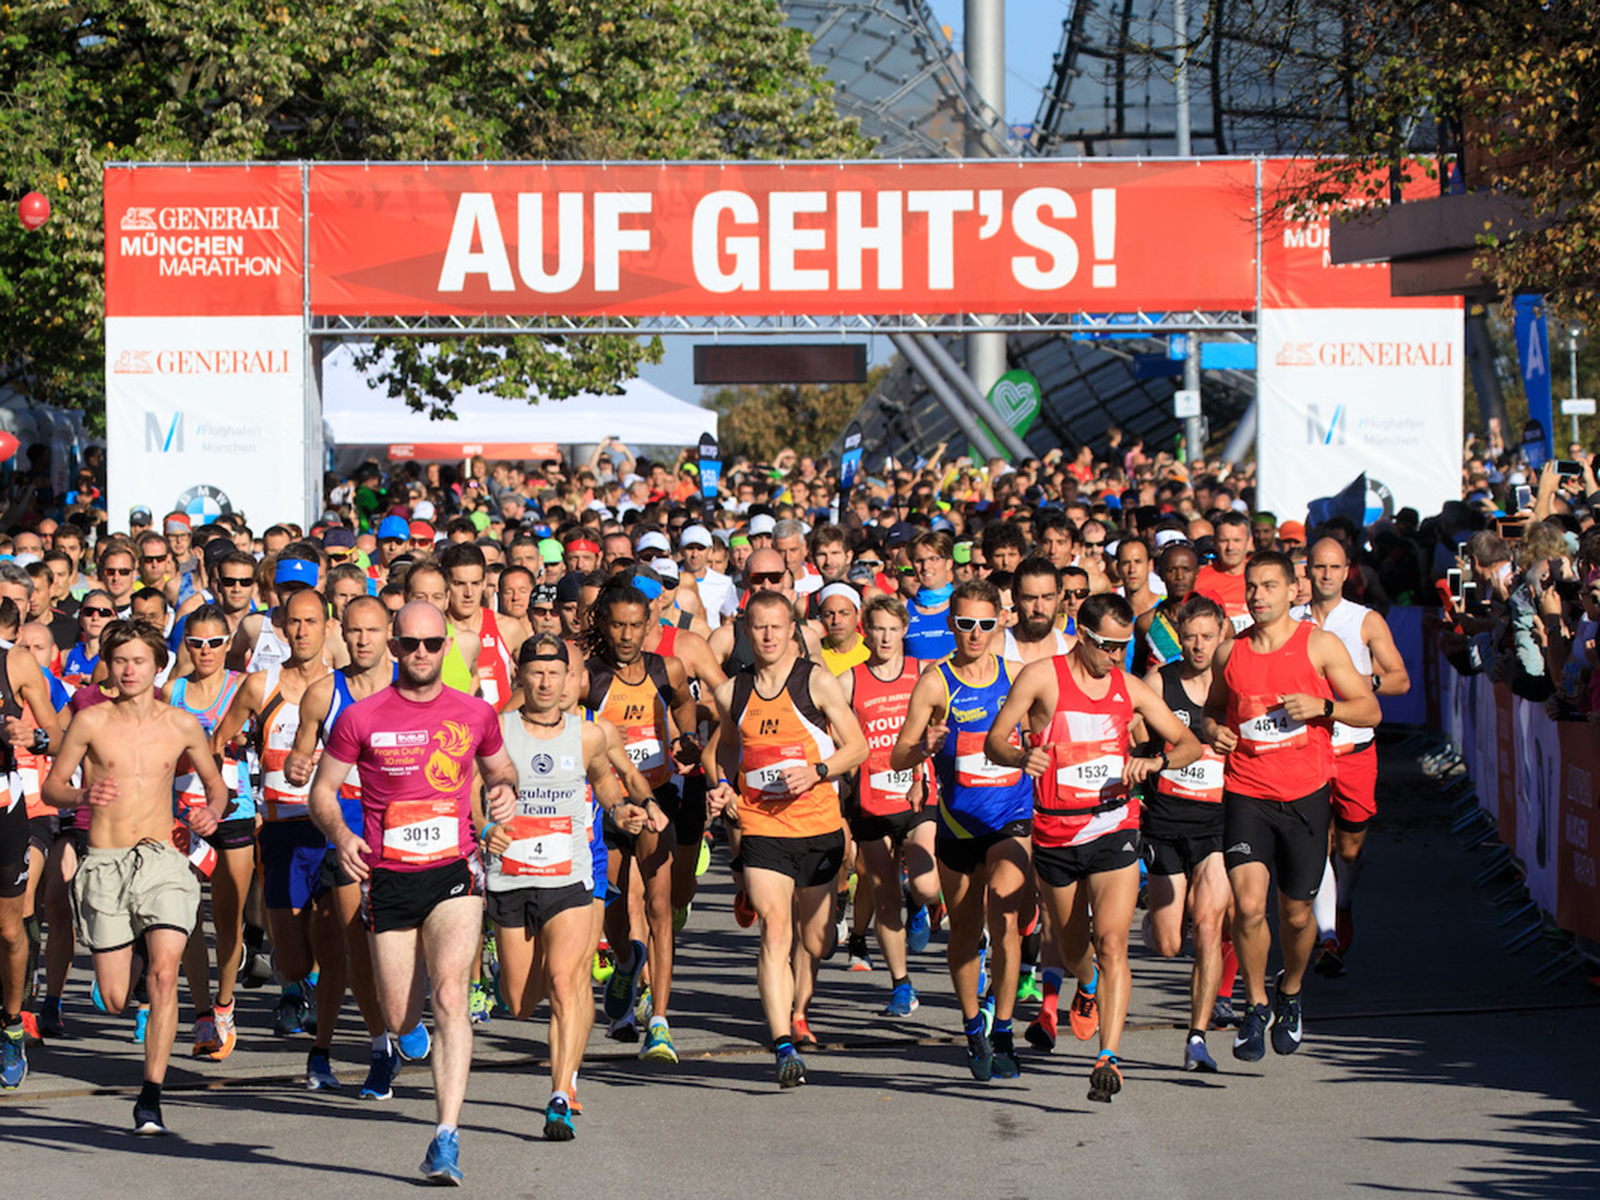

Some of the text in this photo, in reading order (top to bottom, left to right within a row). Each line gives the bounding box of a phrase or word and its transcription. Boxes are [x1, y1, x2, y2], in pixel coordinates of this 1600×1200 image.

[159, 207, 280, 230] GENERALI
[120, 232, 244, 256] MÜNCHEN
[438, 186, 1118, 293] AUF GEHT'S!
[159, 257, 281, 277] MARATHON
[156, 350, 290, 374] GENERALI
[1318, 342, 1454, 367] GENERALI
[181, 485, 228, 506] BMW
[1254, 716, 1288, 732] 4814
[374, 746, 426, 757] Frank Duffy
[384, 756, 415, 765] 10 mile
[1076, 764, 1109, 779] 1532
[1180, 766, 1205, 780] 948
[522, 803, 557, 815] Team
[403, 826, 441, 842] 3013
[533, 842, 543, 855] 4
